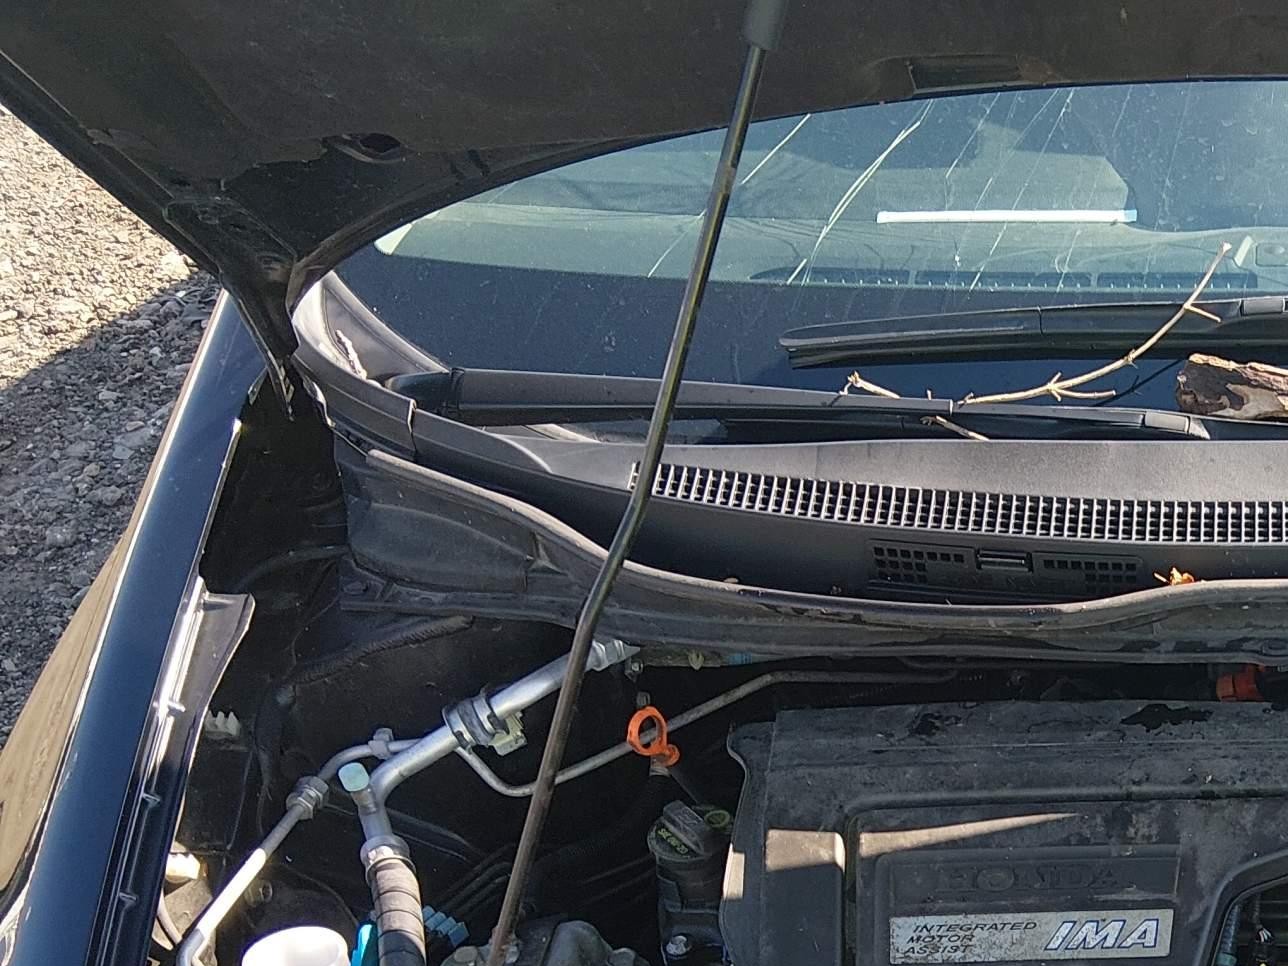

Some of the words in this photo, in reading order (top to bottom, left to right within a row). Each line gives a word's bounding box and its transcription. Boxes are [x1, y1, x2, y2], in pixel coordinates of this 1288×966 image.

[912, 921, 1038, 934] INTEGRATED
[906, 934, 975, 944] MOTOR
[1044, 918, 1160, 951] IMA
[903, 944, 974, 955] ASSIST
